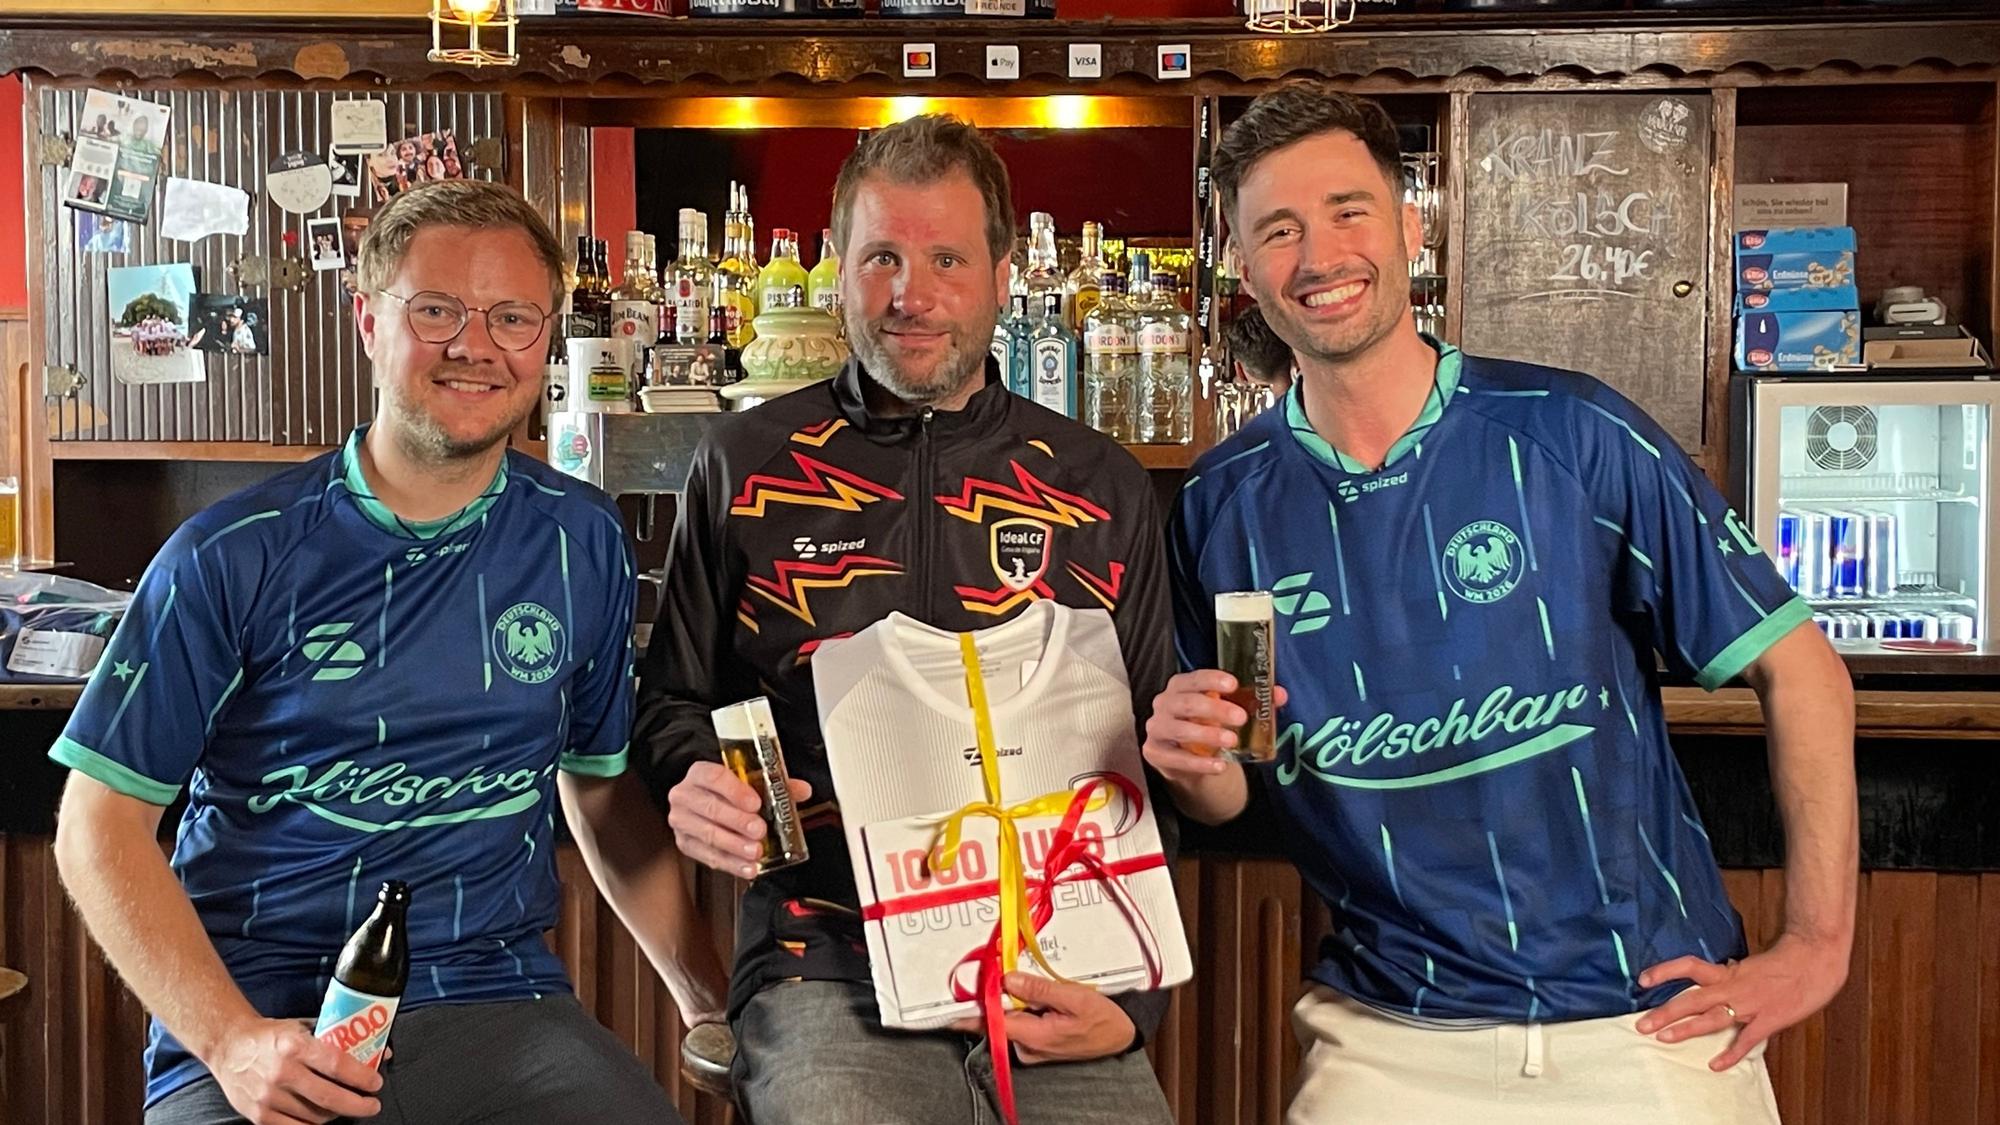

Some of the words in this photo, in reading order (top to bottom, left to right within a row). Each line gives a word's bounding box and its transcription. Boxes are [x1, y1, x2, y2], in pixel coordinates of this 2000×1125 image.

[1075, 57, 1097, 66] VISA
[1487, 128, 1629, 182] KRANZ
[1361, 471, 1408, 494] spized
[820, 538, 866, 555] spized
[1000, 531, 1028, 545] Ideal
[1029, 532, 1044, 545] CF
[1446, 521, 1515, 558] DEUTSCHLAND
[1464, 588, 1484, 601] WM
[1487, 580, 1514, 601] 2026
[497, 604, 561, 631] DEUTSCHLAND
[511, 665, 529, 681] WM
[1275, 684, 1588, 787] Kölschbar
